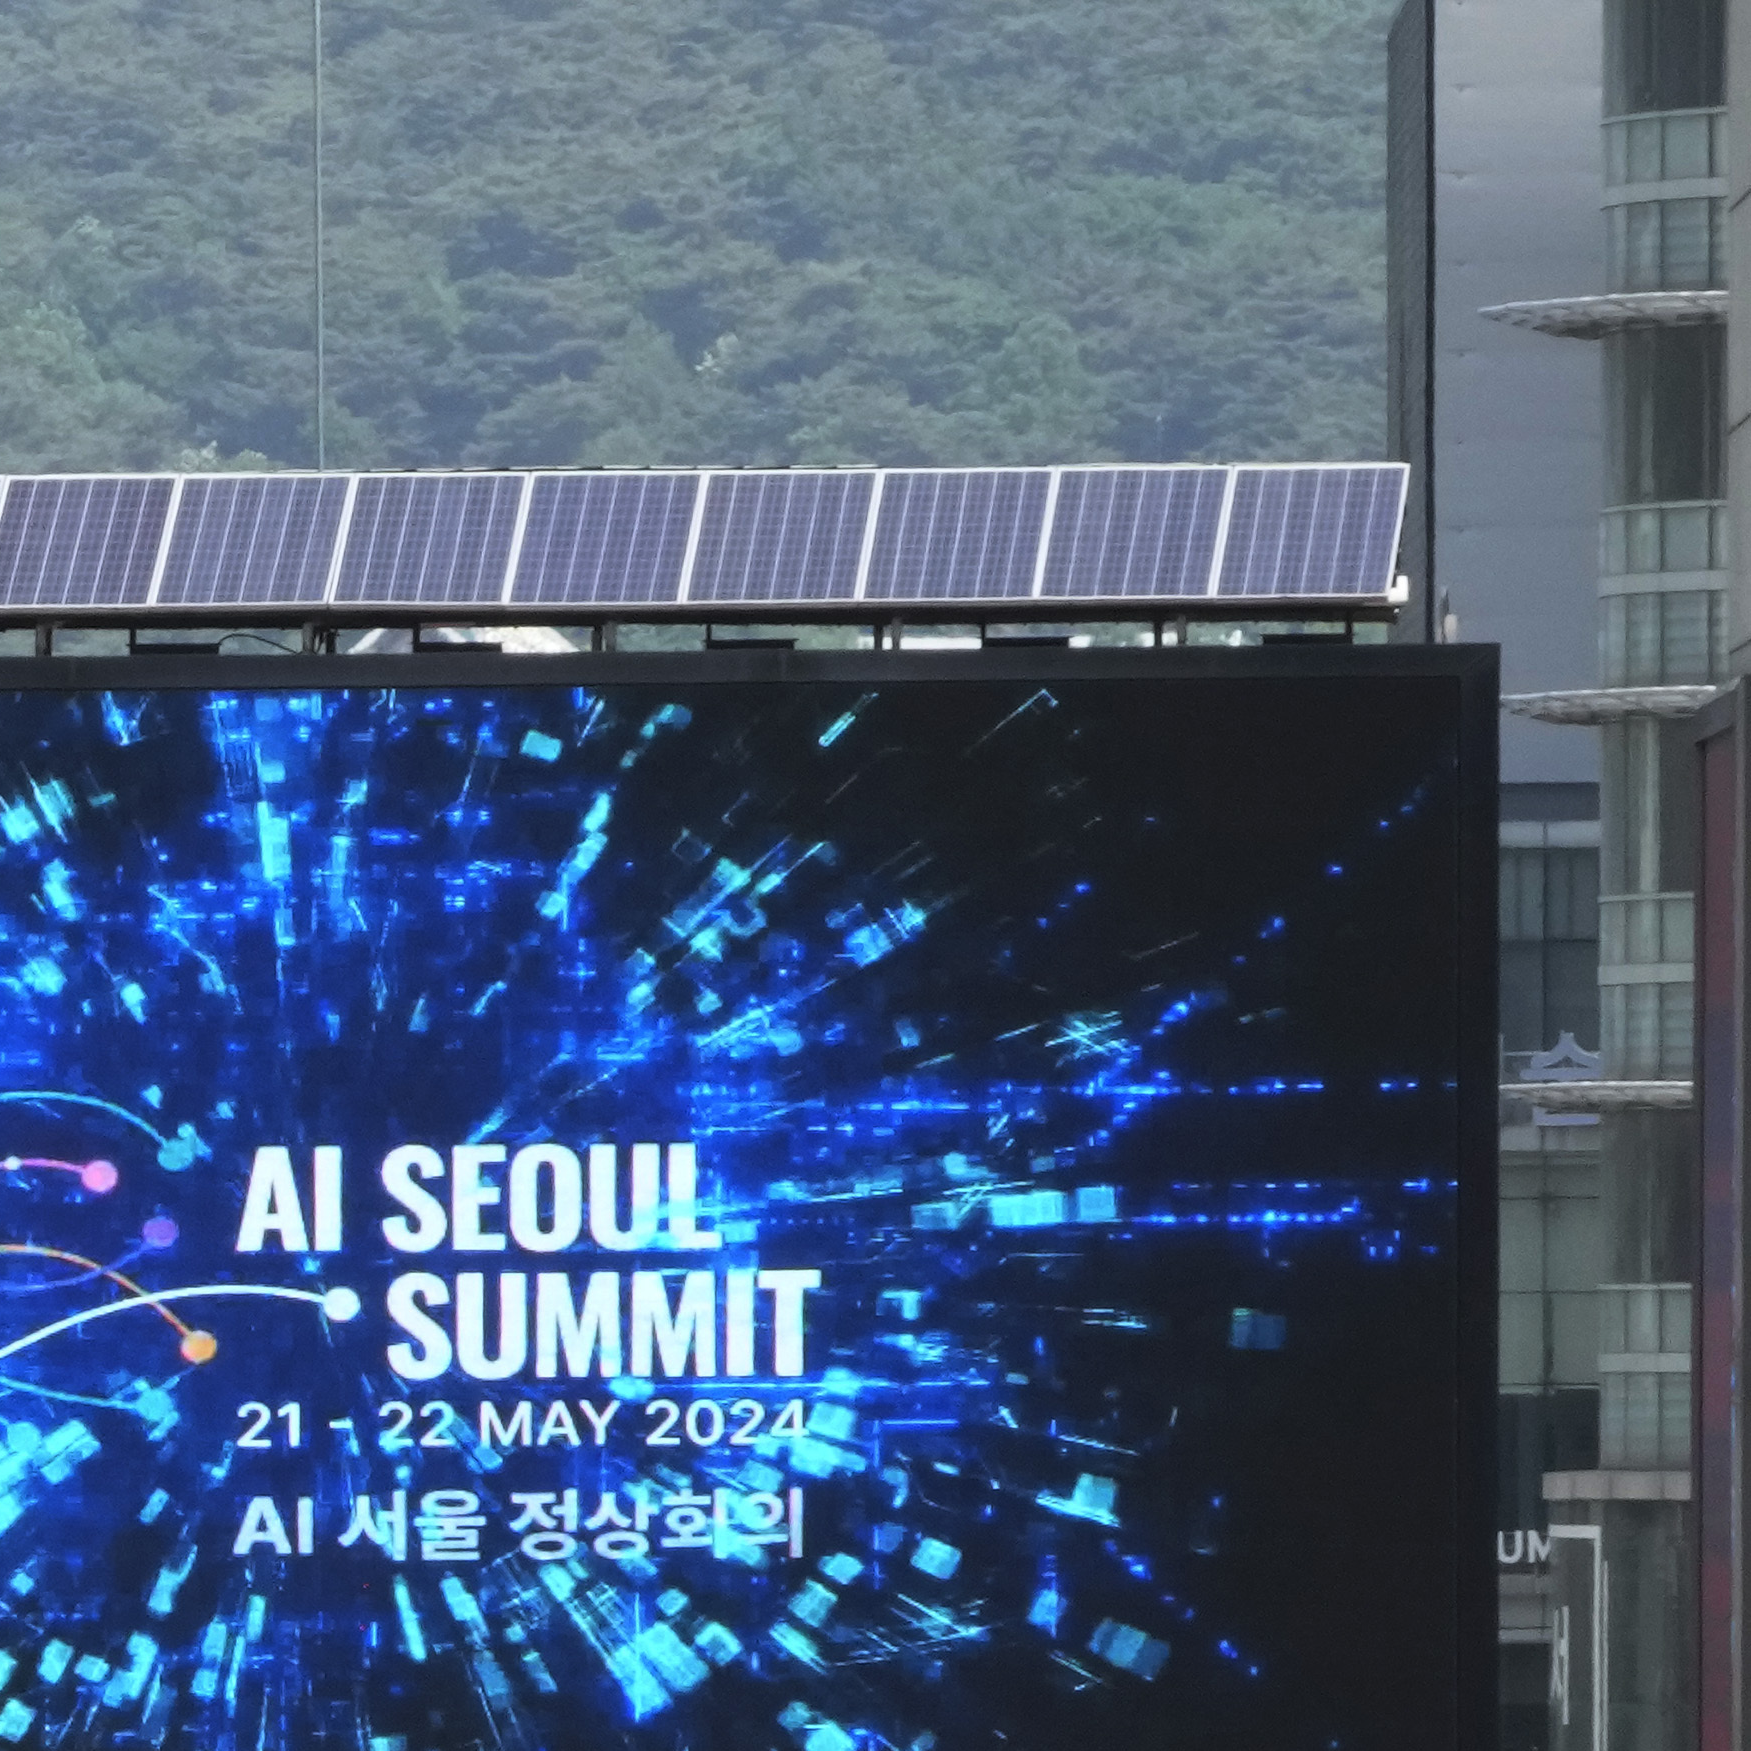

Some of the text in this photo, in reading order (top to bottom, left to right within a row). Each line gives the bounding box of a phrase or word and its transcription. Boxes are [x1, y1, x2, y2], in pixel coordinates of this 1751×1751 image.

[235, 1142, 723, 1254] AI SEOUL
[387, 1268, 822, 1380] SUMMIT
[237, 1403, 301, 1448] 21
[378, 1402, 455, 1447] 22
[480, 1400, 618, 1447] MAY
[646, 1400, 808, 1447] 2024
[234, 1487, 803, 1561] AI 서울 정상회의
